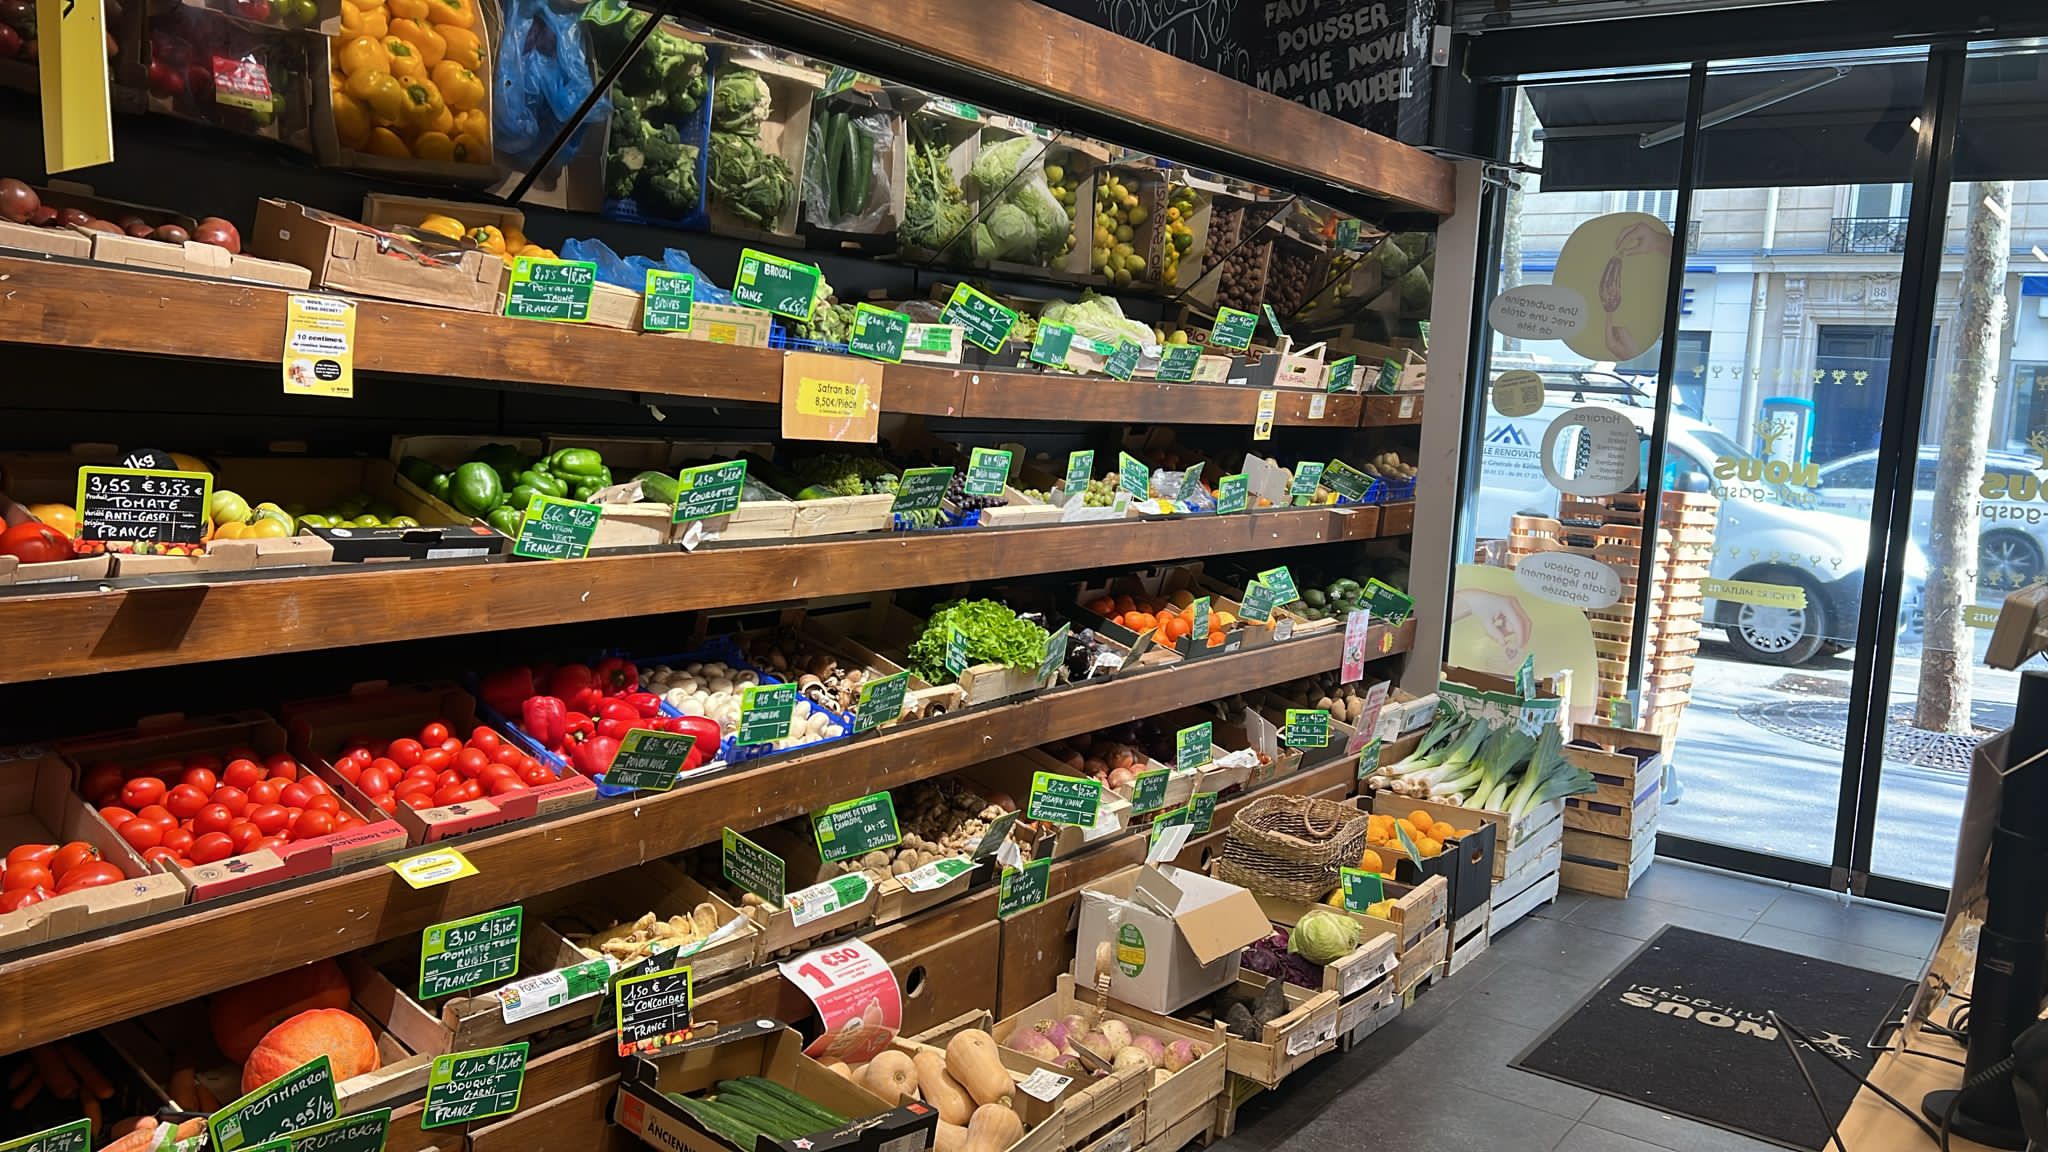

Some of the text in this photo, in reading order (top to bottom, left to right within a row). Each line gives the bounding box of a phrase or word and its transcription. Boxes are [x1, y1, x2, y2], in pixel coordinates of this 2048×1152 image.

[1278, 3, 1389, 56] POUSSER
[736, 285, 764, 303] FRANCE
[1873, 287, 1888, 297] 88
[519, 302, 560, 313] FRANCE
[308, 334, 343, 343] centimes
[817, 383, 857, 395] Safran Bio
[91, 476, 203, 496] 3,55 € 3,55 €
[107, 496, 181, 511] TOMATE
[684, 502, 718, 519] FRANCE
[97, 525, 158, 539] FRANCE
[524, 541, 564, 554] FRANCE
[449, 929, 477, 948] 3,10
[434, 968, 484, 993] FRANCE
[624, 985, 649, 1001] 1,50
[652, 981, 661, 993] €
[634, 992, 687, 1012] CONCOMBRE
[1620, 991, 1779, 1041] NOUS
[634, 1019, 669, 1040] FRANCE
[455, 1060, 486, 1077] 2,10
[446, 1073, 507, 1095] BOUQUET
[240, 1068, 330, 1122] POTIMARRON
[435, 1101, 478, 1123] FRANCE
